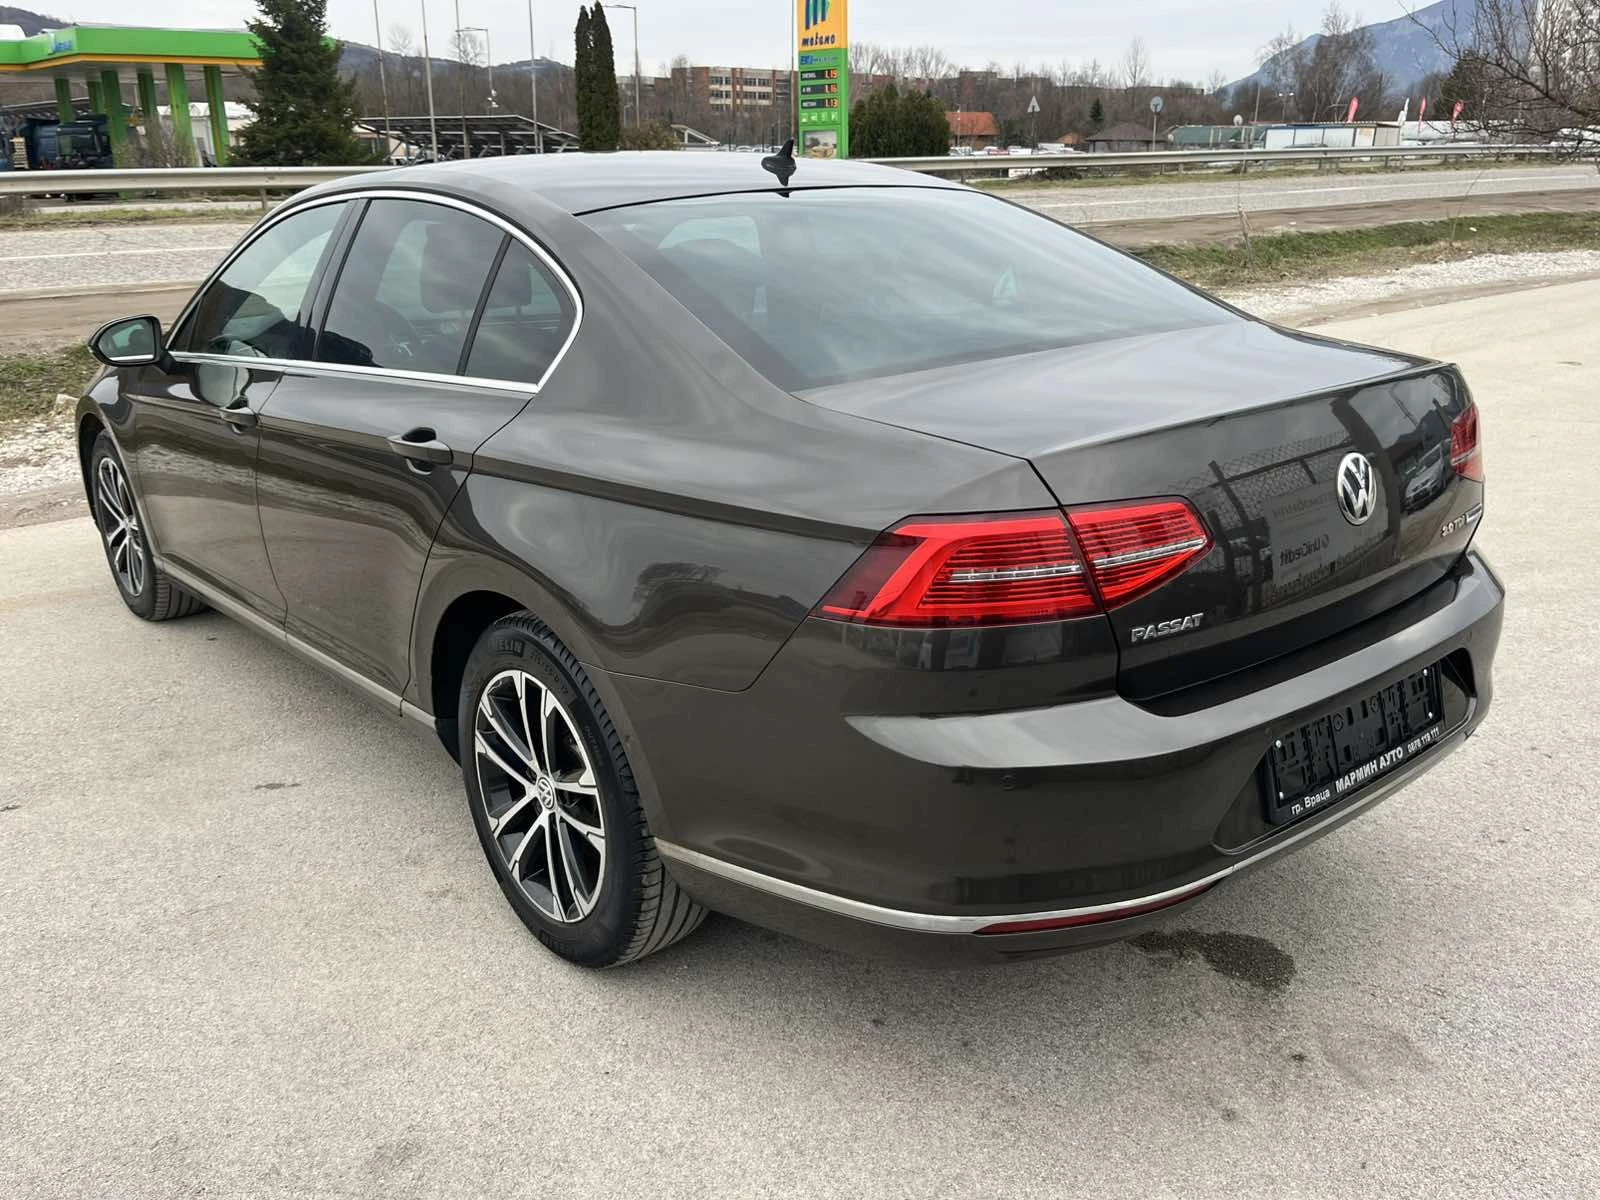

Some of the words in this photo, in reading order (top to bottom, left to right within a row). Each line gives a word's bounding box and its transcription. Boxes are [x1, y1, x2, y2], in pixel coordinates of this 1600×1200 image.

[1131, 612, 1204, 642] PASSAT
[1291, 803, 1304, 816] гр.
[1304, 788, 1331, 808] Враца
[1335, 759, 1378, 793] МАРМИН
[1380, 746, 1404, 769] АУТО
